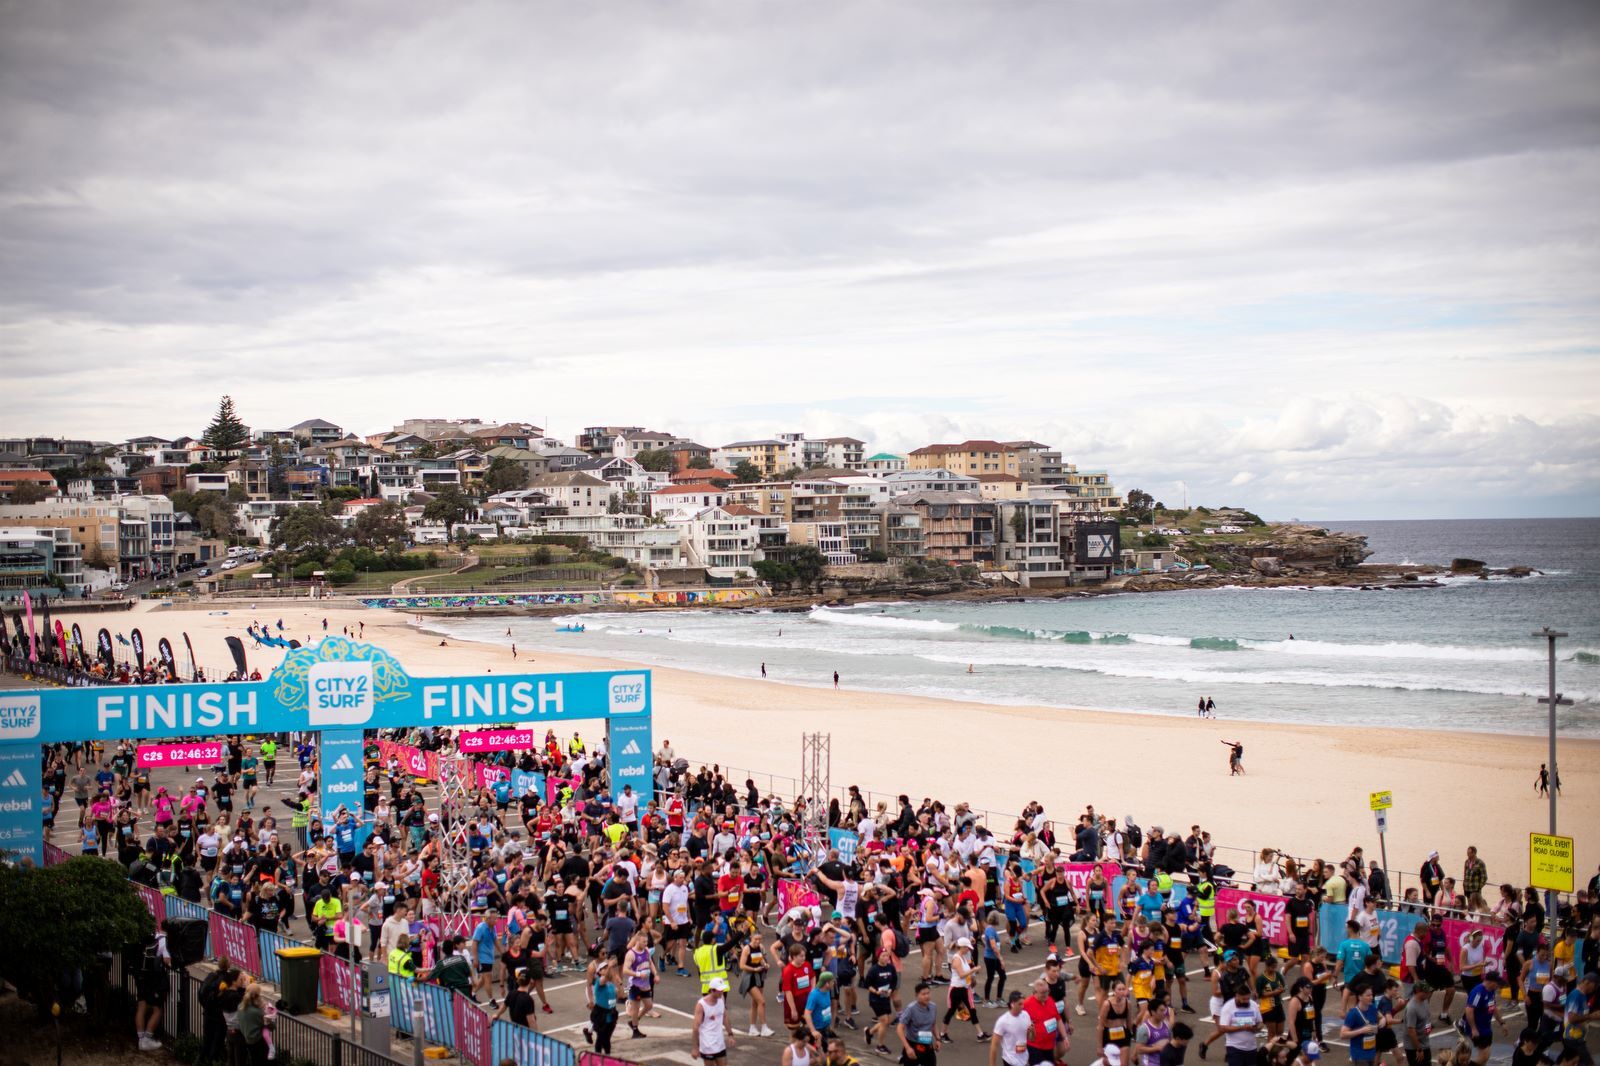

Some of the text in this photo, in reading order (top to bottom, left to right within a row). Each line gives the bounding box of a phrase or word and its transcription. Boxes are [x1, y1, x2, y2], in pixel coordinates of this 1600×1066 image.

[318, 694, 365, 708] SURF
[423, 680, 564, 719] FINISH
[614, 694, 640, 703] SURF
[98, 691, 257, 731] FINISH
[1, 717, 35, 728] SURF
[489, 734, 531, 745] 02:46:32
[171, 747, 218, 760] 02:46:32
[619, 764, 645, 776] rebel
[328, 781, 358, 793] rebel
[838, 837, 854, 850] CIT
[1533, 837, 1570, 848] SPECIAL EVENT
[1533, 847, 1569, 858] ROAD CLOSED
[1237, 898, 1286, 921] CTY2
